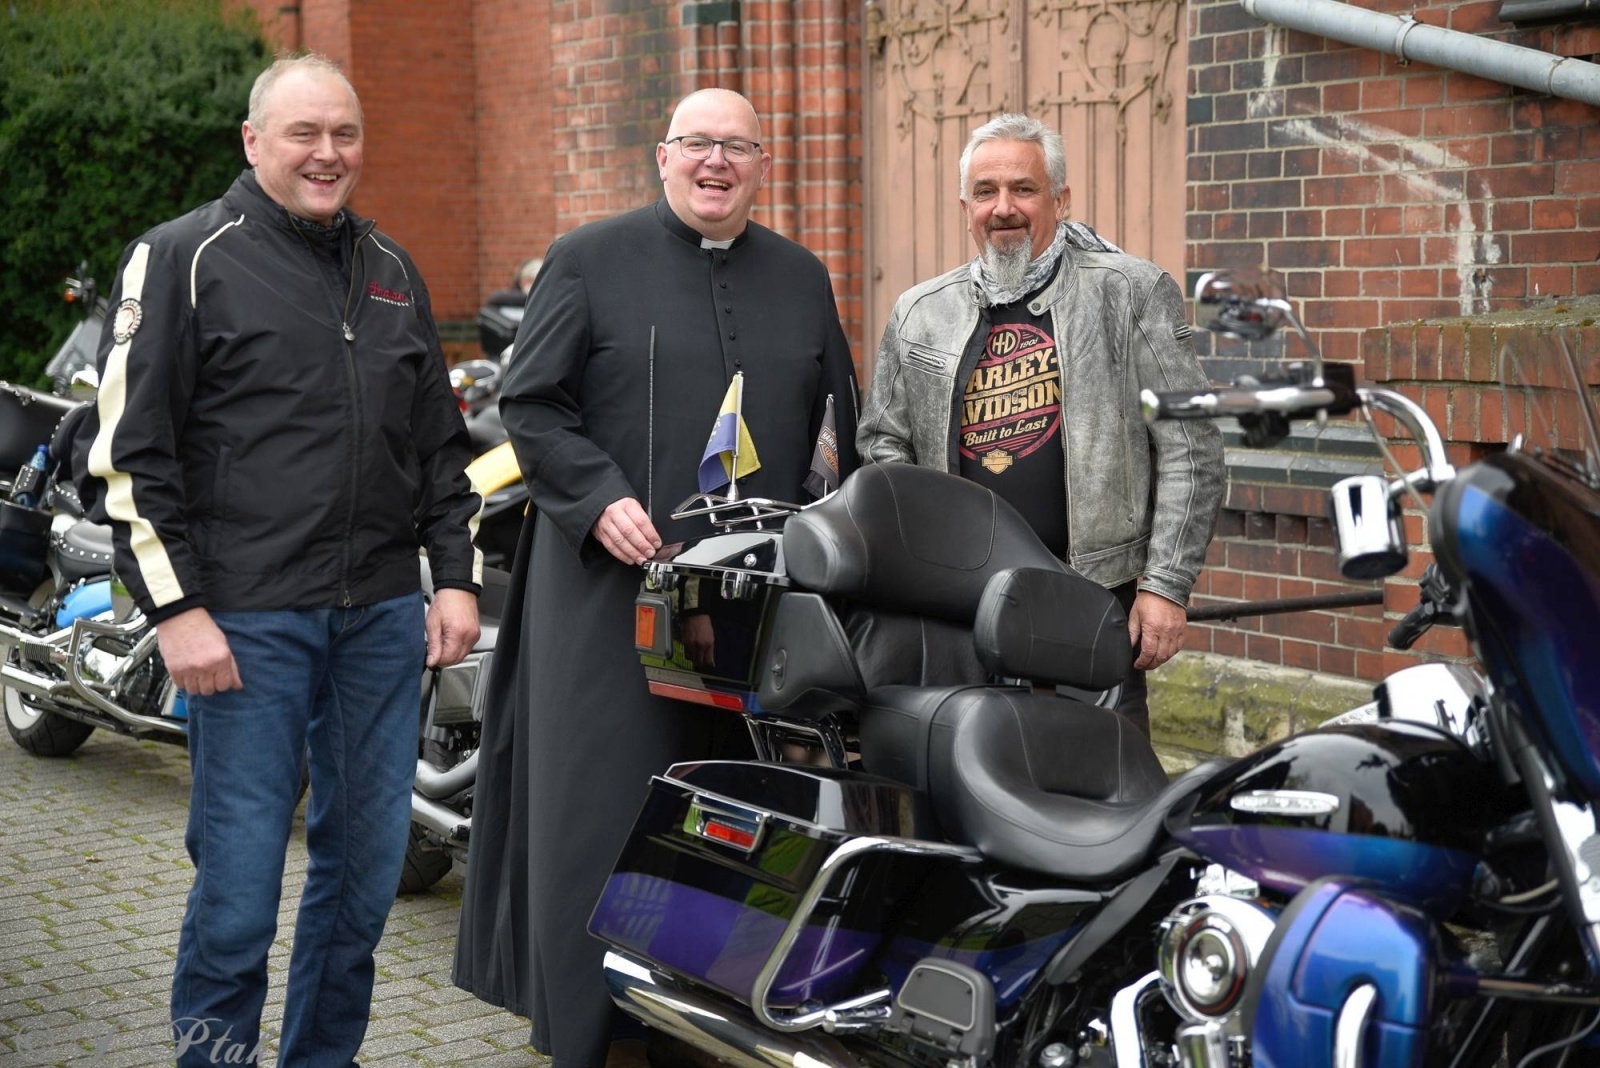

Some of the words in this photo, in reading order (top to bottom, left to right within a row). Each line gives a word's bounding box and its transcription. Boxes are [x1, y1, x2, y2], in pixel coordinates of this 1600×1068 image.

[966, 348, 1058, 394] ARLEY-
[961, 380, 1062, 427] VIDSON
[964, 429, 998, 446] Built
[999, 427, 1012, 440] to
[1013, 416, 1048, 435] Last
